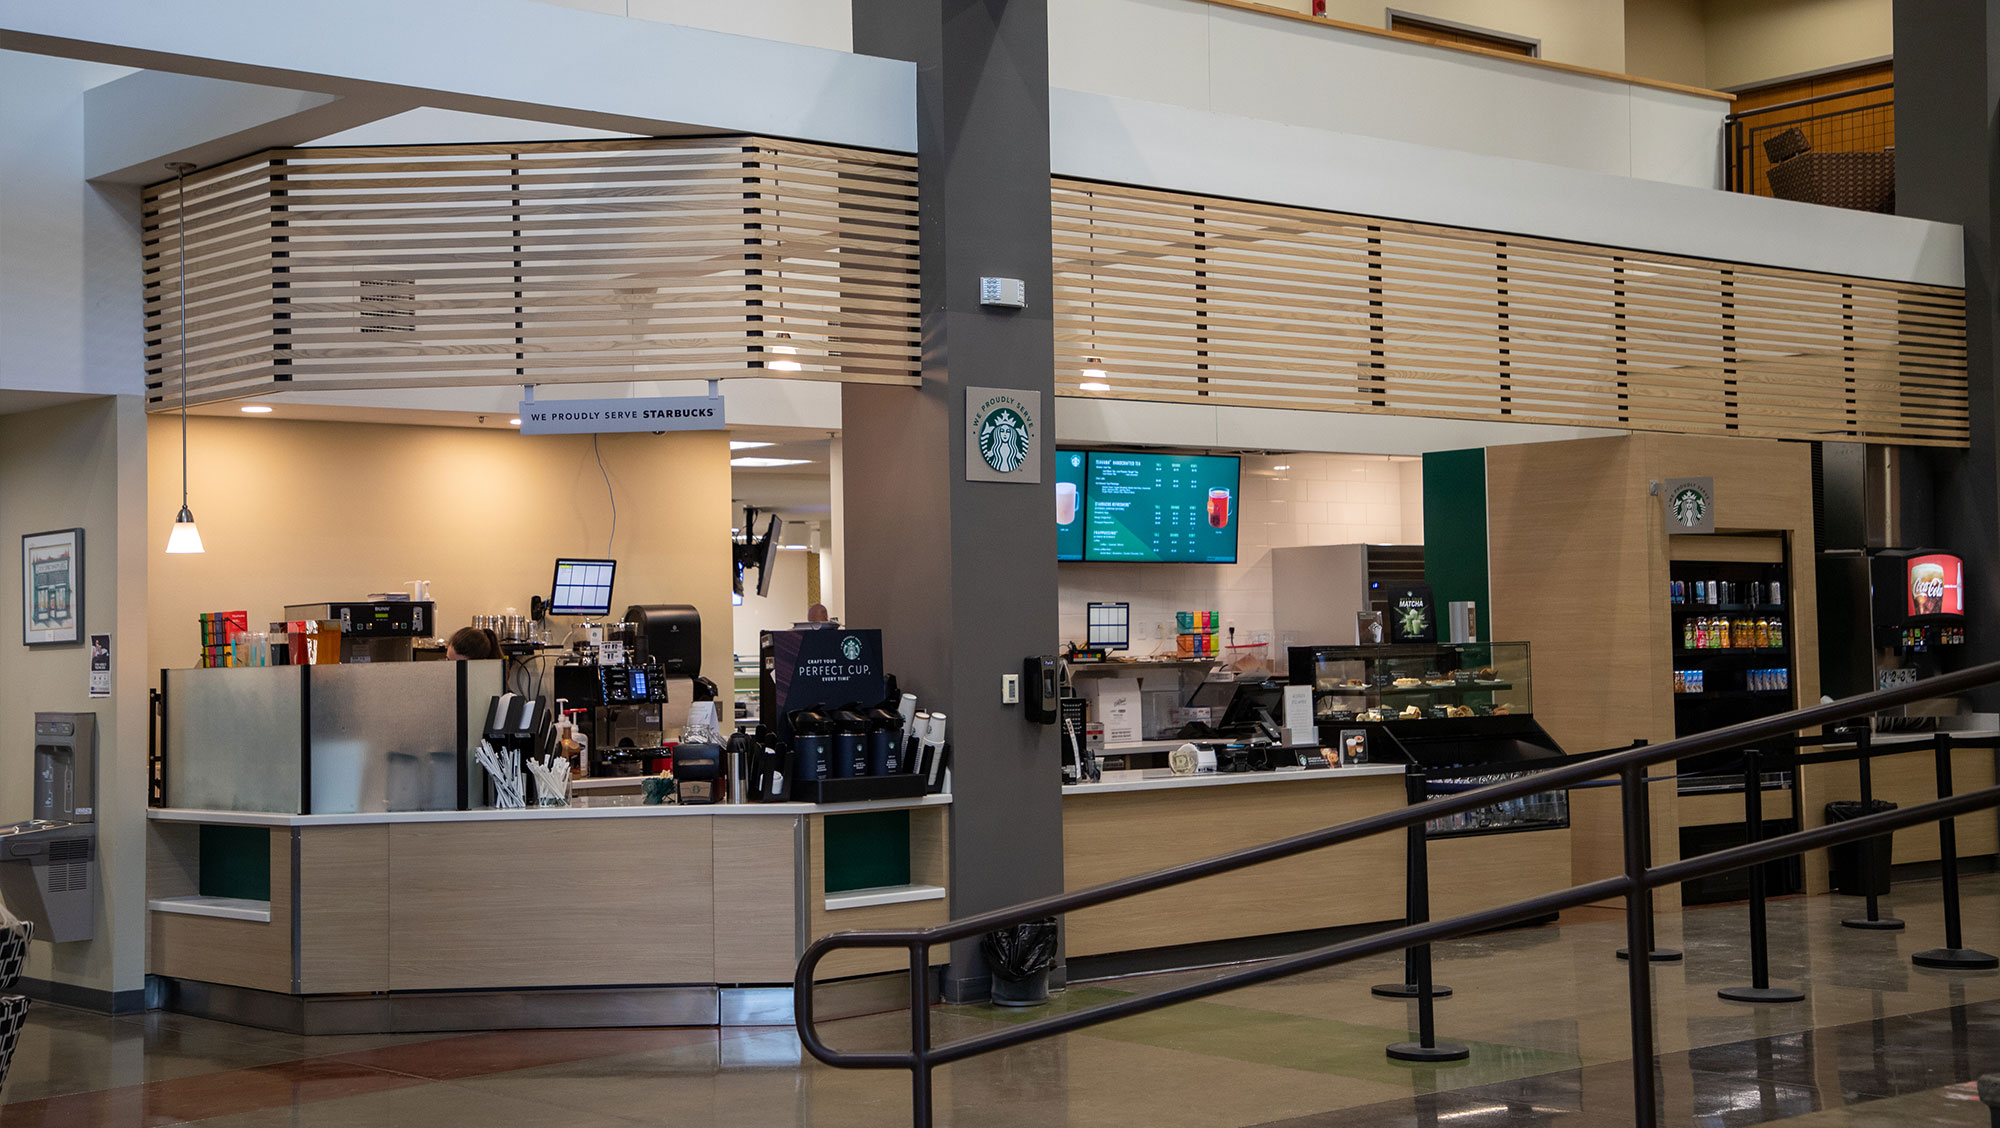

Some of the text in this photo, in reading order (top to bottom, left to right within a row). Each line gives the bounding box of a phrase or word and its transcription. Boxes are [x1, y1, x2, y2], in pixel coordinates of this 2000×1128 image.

[531, 408, 715, 421] WE PROUDLY SERVE STARBUCKS
[973, 396, 1034, 428] WE PROUDLY SERVE
[1399, 600, 1424, 608] MATCHA
[799, 665, 843, 676] PERFECT
